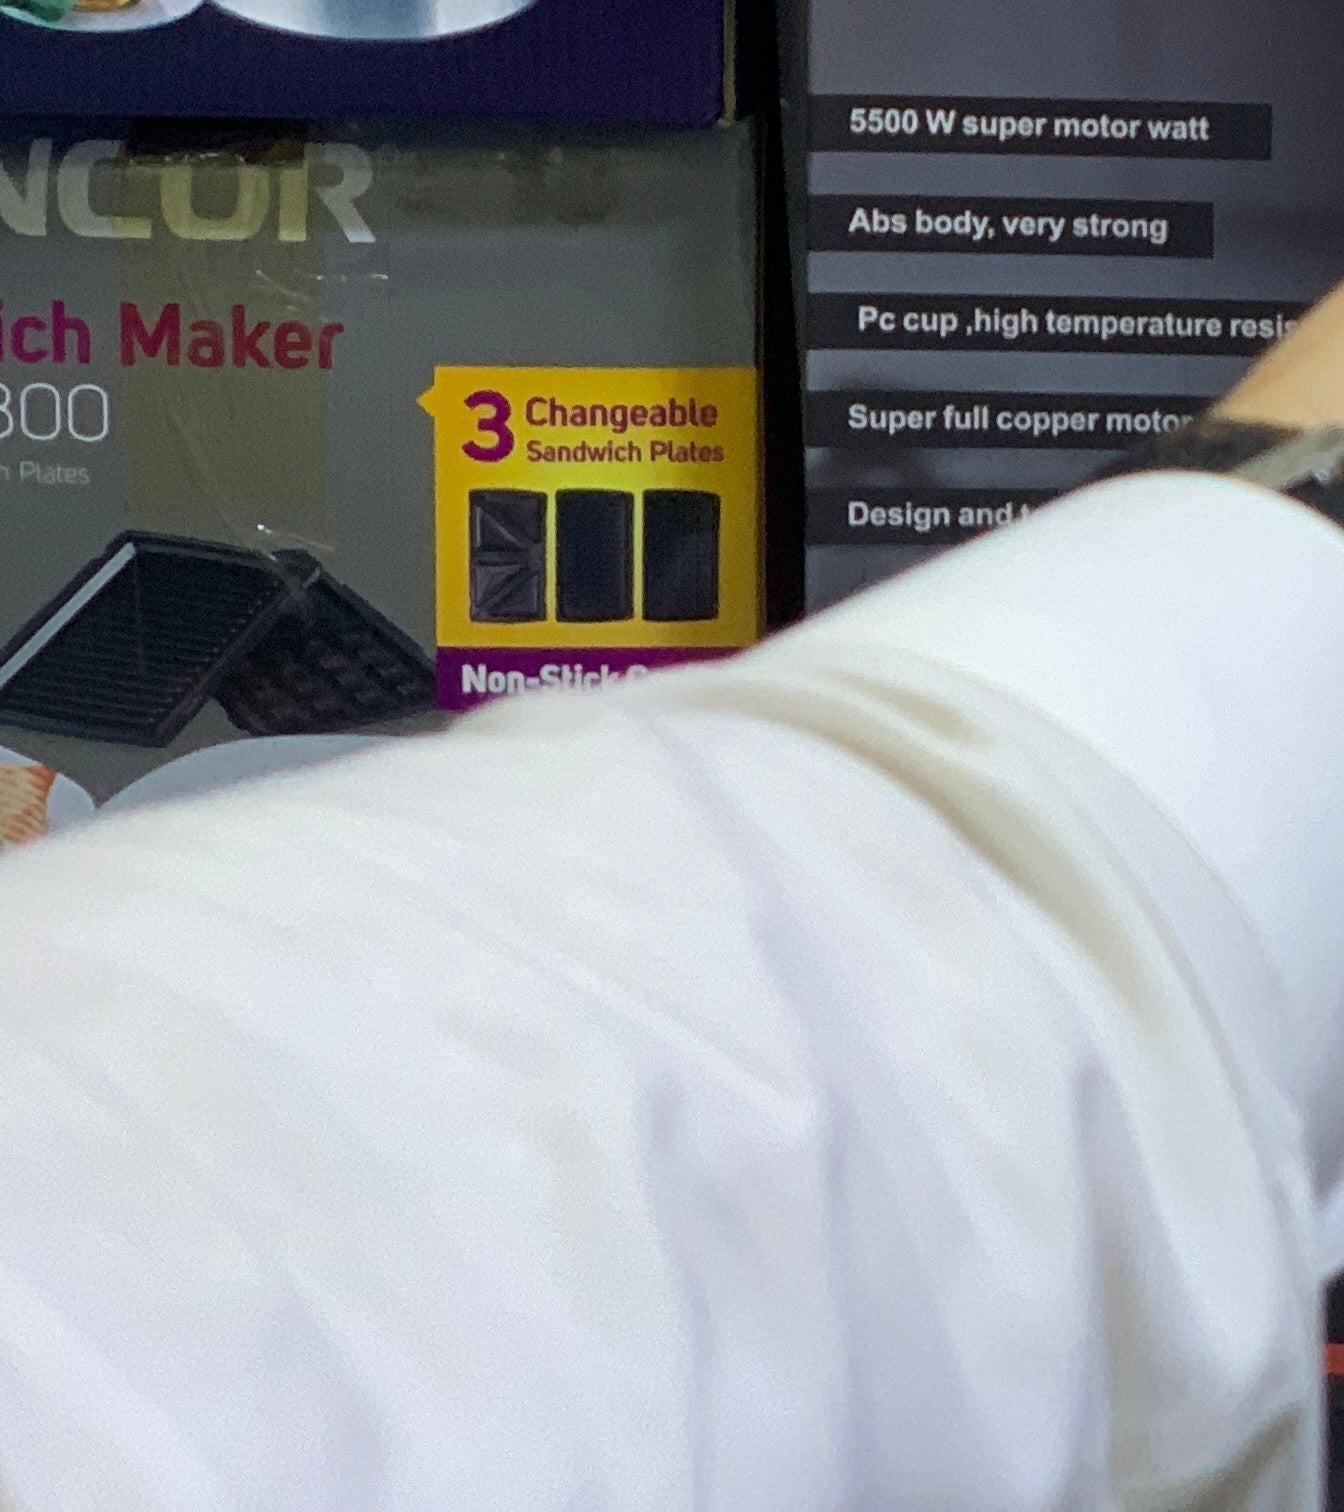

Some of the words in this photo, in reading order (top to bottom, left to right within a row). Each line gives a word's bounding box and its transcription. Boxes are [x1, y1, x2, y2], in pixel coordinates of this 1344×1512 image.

[848, 107, 918, 136] 5500
[925, 109, 958, 136] W
[961, 113, 1048, 145] super
[1053, 113, 1142, 140] motor
[1148, 115, 1211, 142] watt
[848, 207, 908, 235] Abs
[914, 208, 996, 246] body,
[1002, 216, 1066, 246] very
[1072, 214, 1170, 246] strong
[118, 301, 346, 370] Maker
[857, 306, 896, 333] Pc
[902, 311, 959, 340] cup
[965, 308, 1038, 340] ,high
[1044, 310, 1223, 343] temperature
[462, 389, 516, 463] 3
[525, 396, 719, 433] Changeable
[848, 405, 937, 437] Super
[942, 405, 989, 432] full
[995, 410, 1099, 440] copper
[526, 440, 643, 464] Sandwich
[650, 440, 726, 465] Plates
[19, 460, 91, 486] Plates
[847, 501, 950, 534] Design
[958, 501, 1013, 528] and
